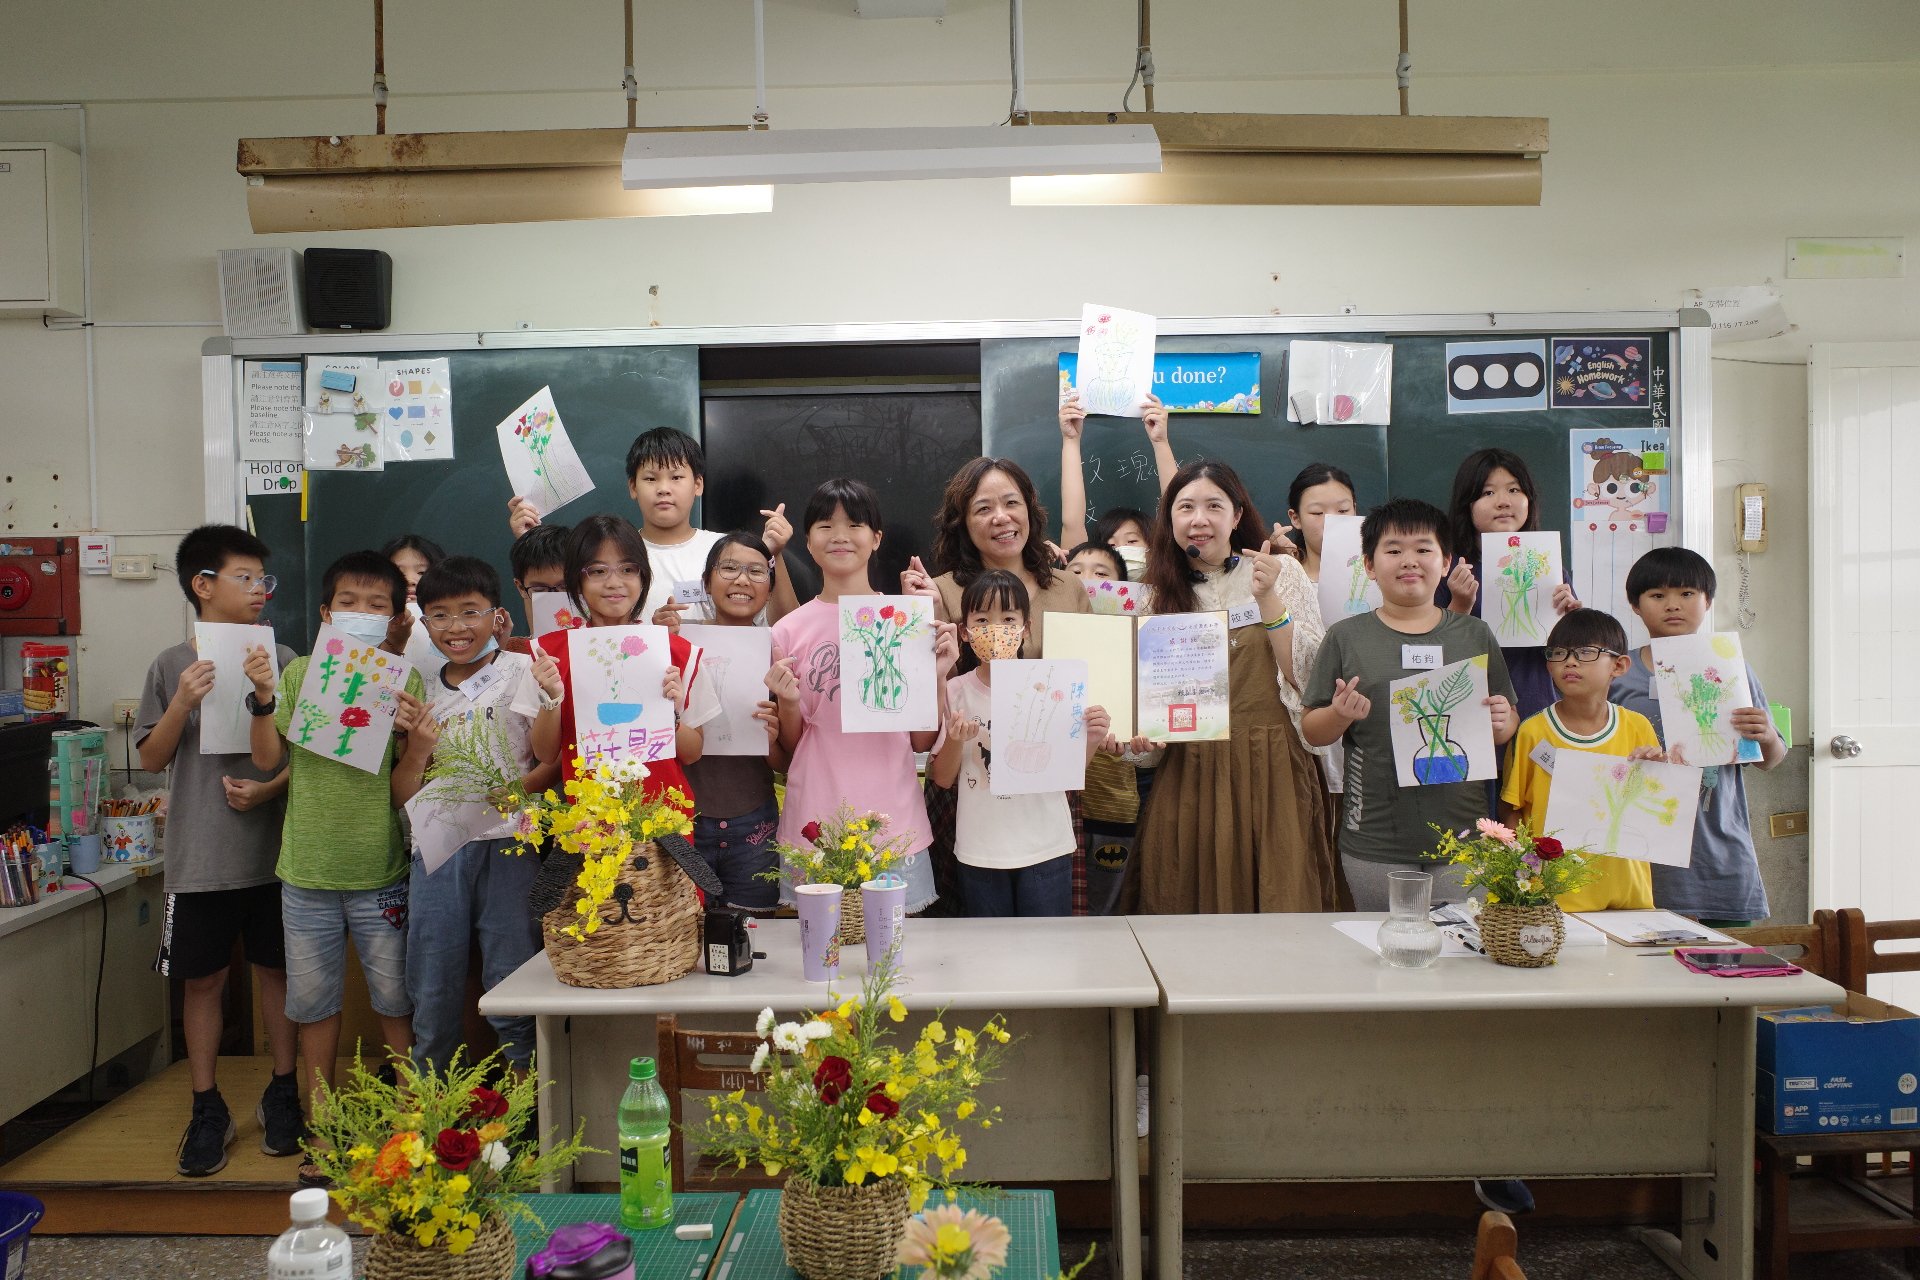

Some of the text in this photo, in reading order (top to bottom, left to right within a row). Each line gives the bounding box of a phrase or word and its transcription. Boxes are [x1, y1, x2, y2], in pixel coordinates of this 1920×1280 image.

[397, 367, 431, 376] SHAPES
[1587, 360, 1615, 371] English
[1171, 366, 1227, 384] done?
[1576, 371, 1626, 384] Homework
[290, 404, 301, 412] the
[250, 460, 303, 475] Hold on
